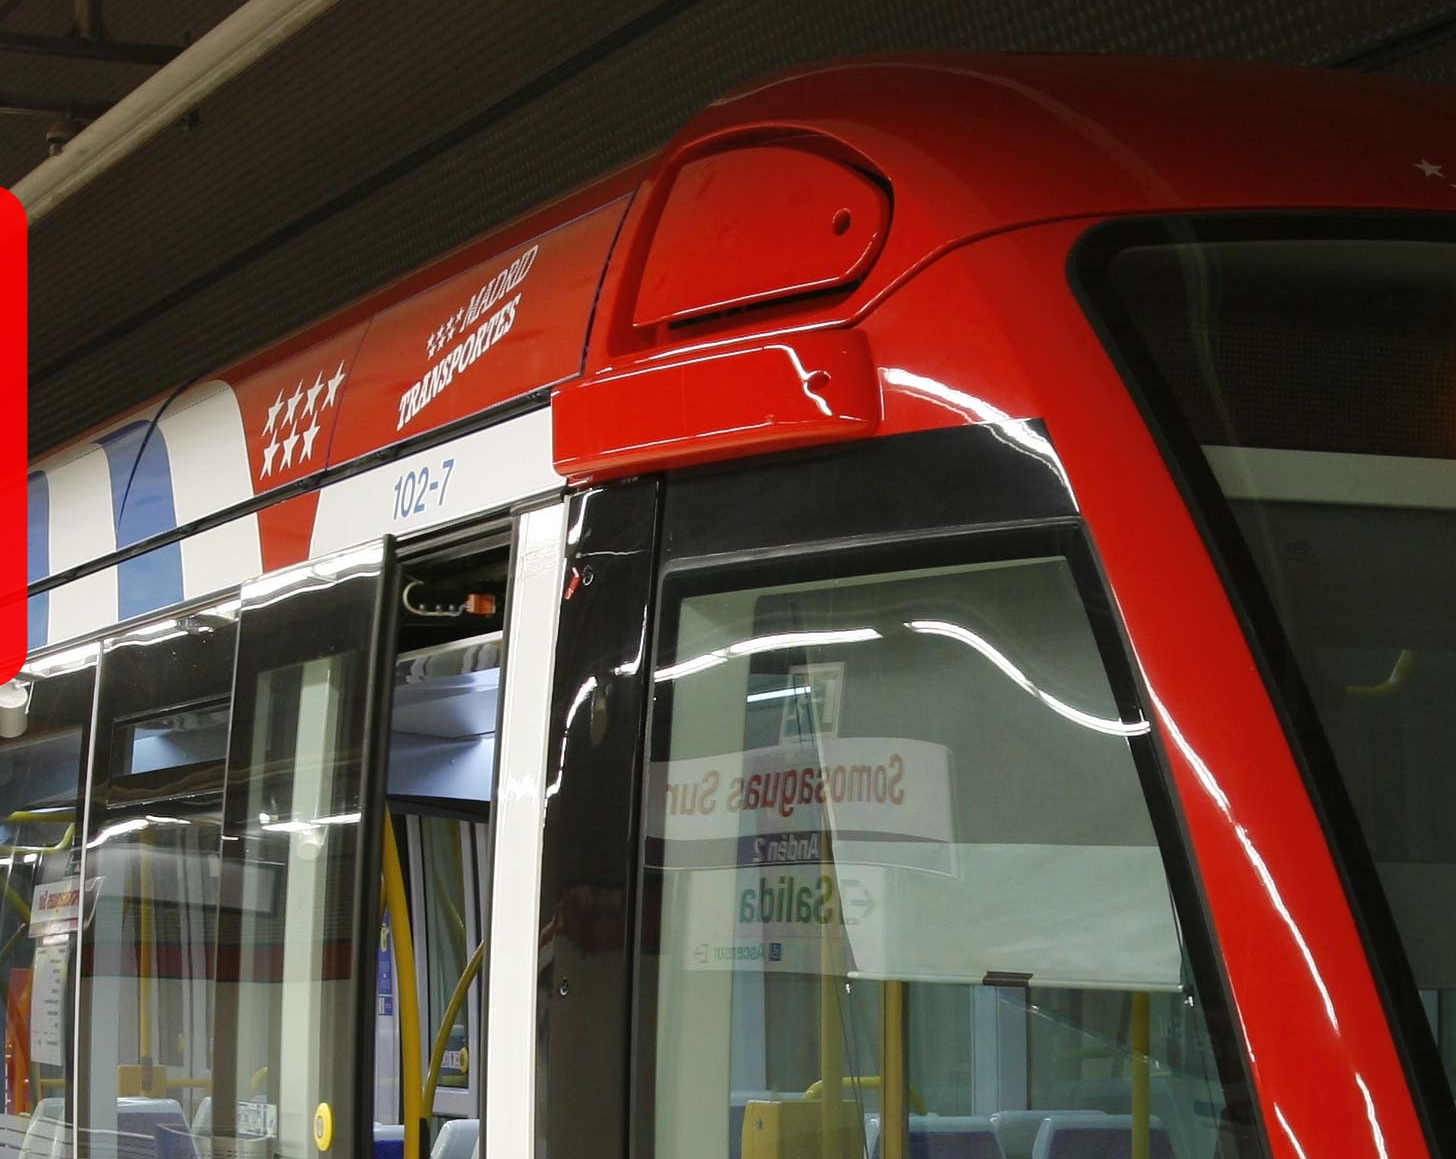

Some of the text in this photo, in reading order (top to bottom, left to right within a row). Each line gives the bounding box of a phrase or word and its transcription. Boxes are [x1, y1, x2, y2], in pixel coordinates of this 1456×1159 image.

[459, 244, 539, 333] MADRID
[397, 292, 522, 431] TRANSPORTES
[393, 459, 454, 520] 102-7
